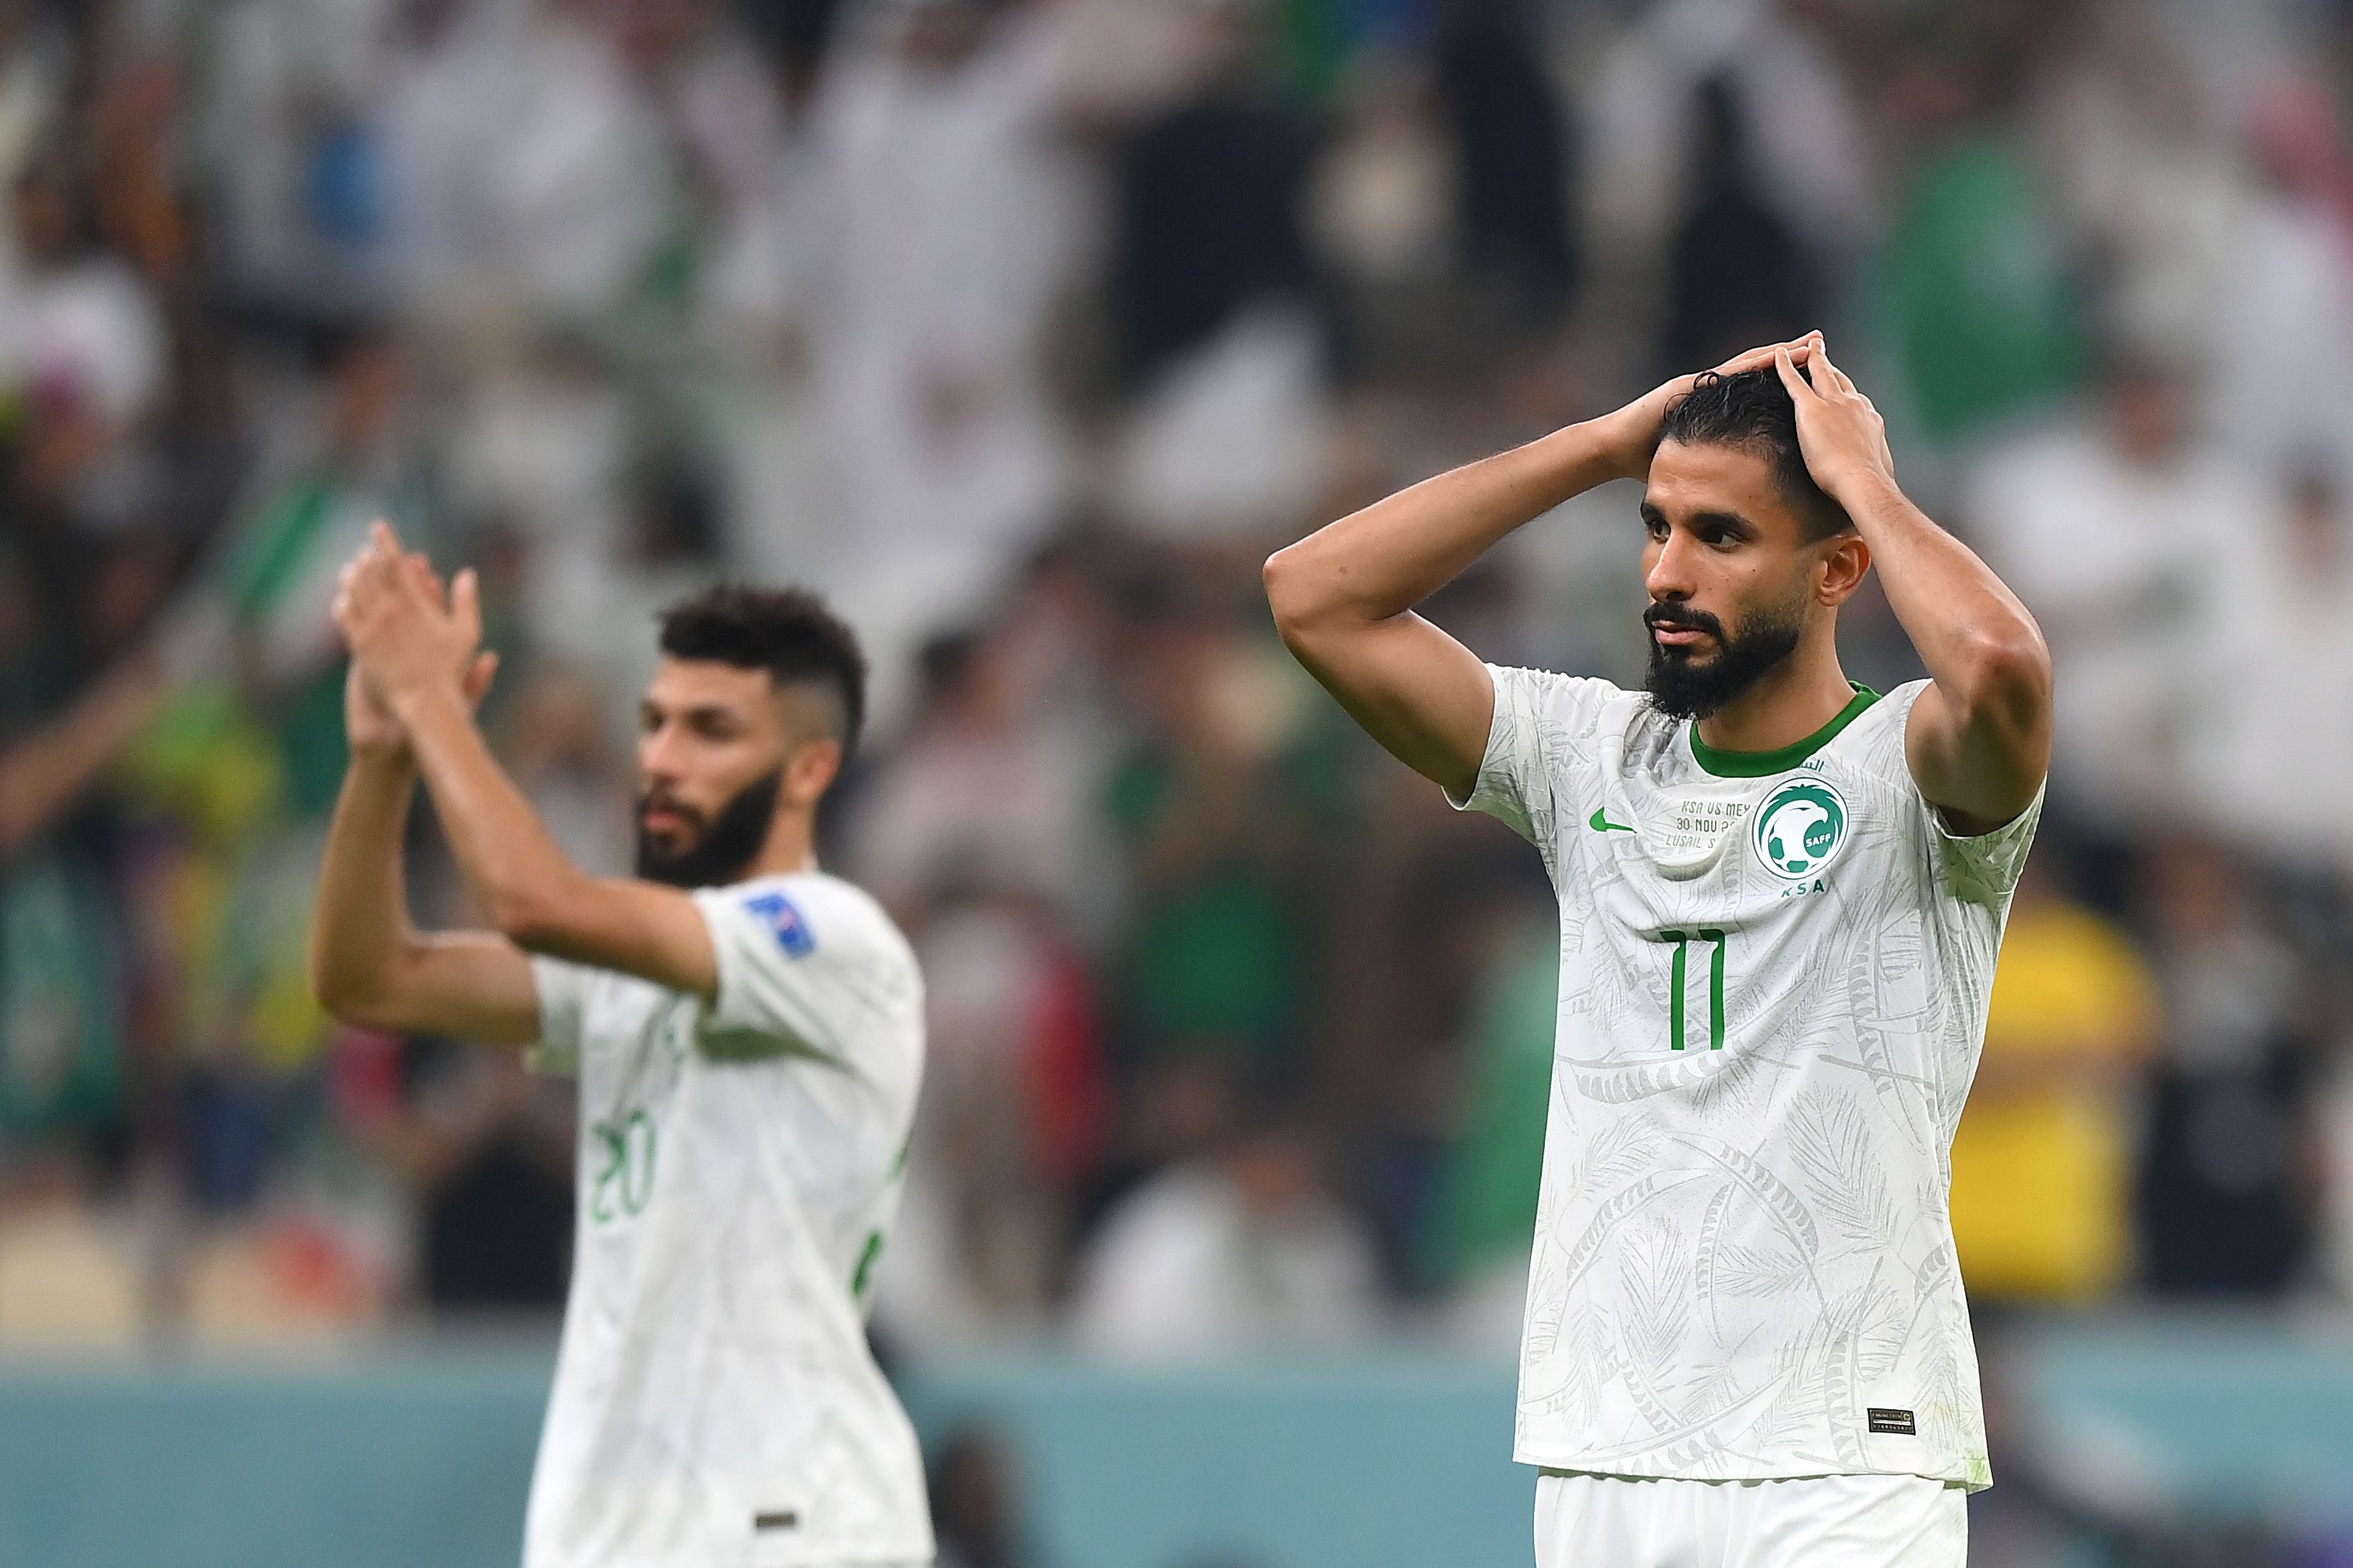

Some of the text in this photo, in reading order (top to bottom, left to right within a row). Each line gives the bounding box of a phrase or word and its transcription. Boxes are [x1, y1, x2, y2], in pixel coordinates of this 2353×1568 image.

[1681, 800, 1704, 815] KSA
[1677, 817, 1691, 831] 30
[1666, 834, 1716, 849] LUSAIL S
[1805, 833, 1832, 848] SAFF
[1659, 928, 1726, 1051] 11
[592, 1109, 657, 1226] 20
